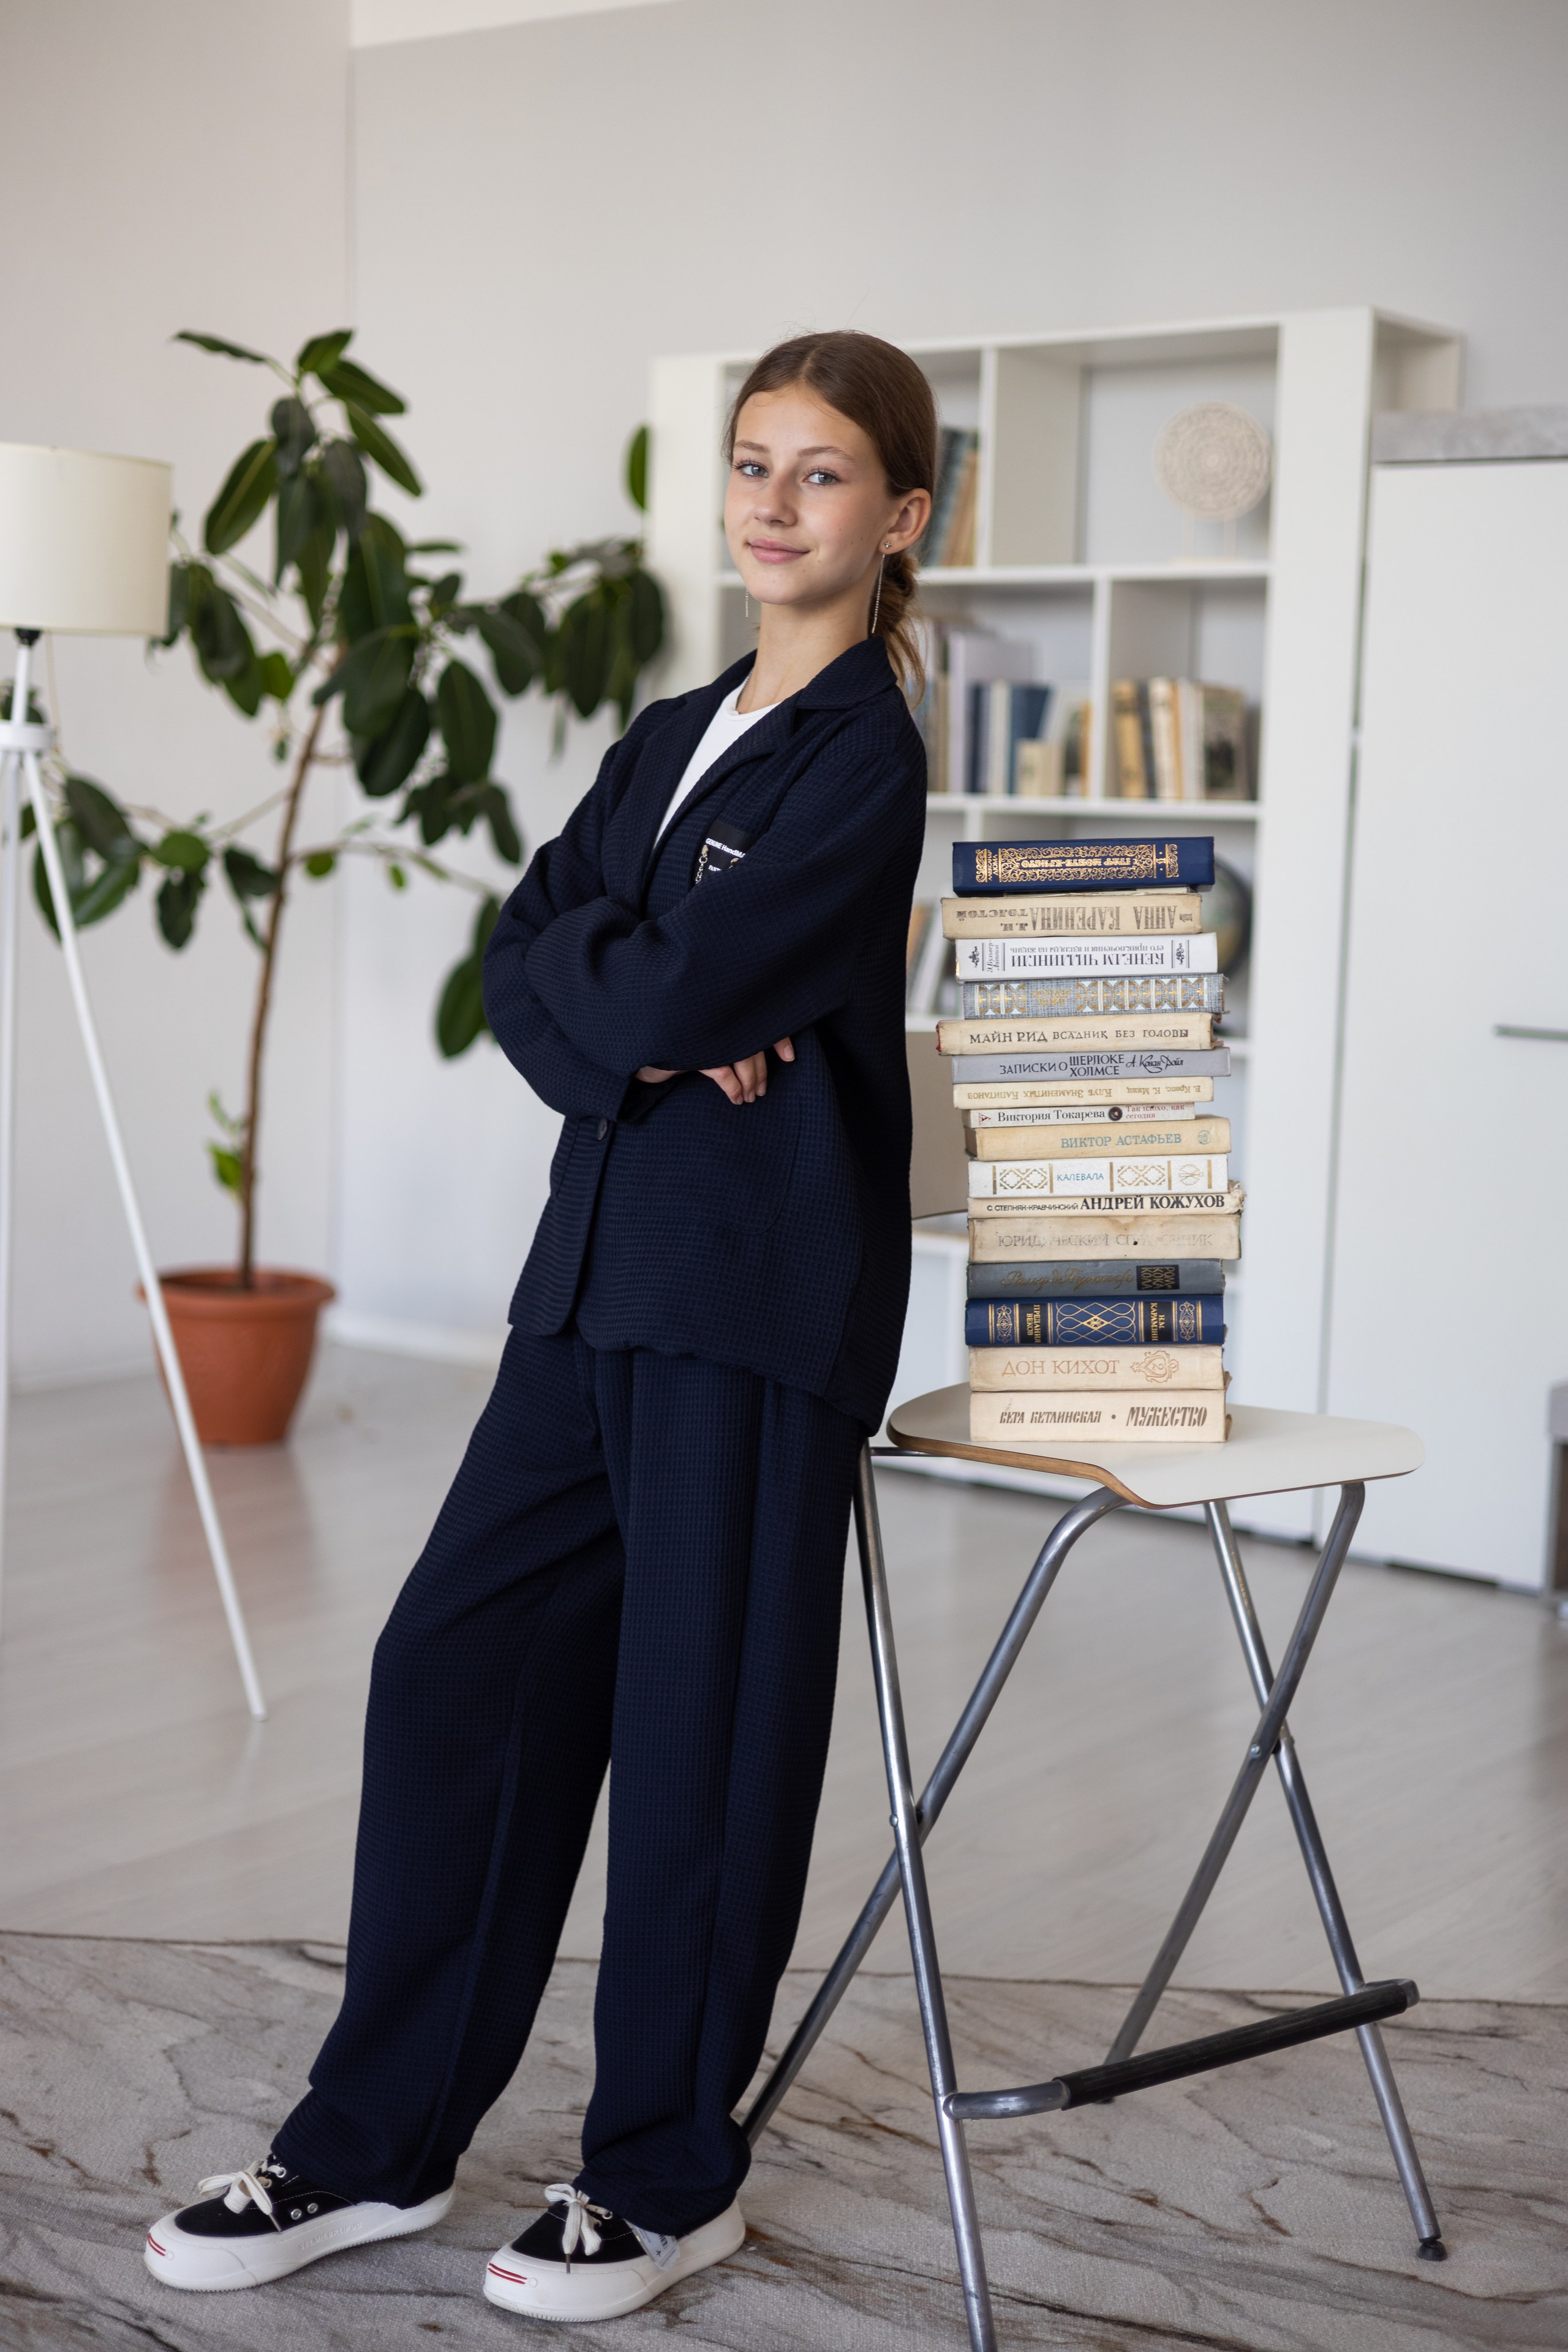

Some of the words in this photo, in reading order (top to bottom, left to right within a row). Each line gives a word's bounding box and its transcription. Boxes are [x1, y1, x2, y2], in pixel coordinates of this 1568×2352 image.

[956, 909, 1028, 921] ТОЛСТОЙ
[1028, 906, 1121, 930] КАРЕНИНА
[1133, 906, 1178, 930] АННА
[1091, 943, 1148, 952] приключения
[1011, 953, 1099, 967] ЧИЛЛИНГЛИ
[1101, 952, 1164, 967] КЕНЕЛМ
[970, 1031, 1012, 1044] МАЙН
[1017, 1031, 1047, 1043] РИД
[1052, 1030, 1109, 1041] ВСАДНИК
[1115, 1030, 1136, 1038] БЕЗ
[1143, 1029, 1189, 1038] ГОЛОВЫ
[1000, 1063, 1057, 1075] ЗАПИСКИ
[1058, 1062, 1068, 1072] О
[1069, 1054, 1125, 1066] ШЕРЛОКЕ
[1069, 1065, 1120, 1077] ХОЛМСЕ
[1139, 1055, 1163, 1073] Конан
[1161, 1055, 1183, 1070] Дойл
[1126, 1087, 1150, 1095] Минц
[998, 1111, 1051, 1122] Виктория
[1054, 1109, 1105, 1120] Токарева
[1060, 1137, 1112, 1148] ВИКТОР
[1115, 1134, 1182, 1145] АСТАФЬЕВ
[1057, 1172, 1104, 1182] КАЛЕВАЛА
[995, 1202, 1078, 1212] СТЕПНЯК-КРАВЧИНСКИЙ
[1080, 1196, 1144, 1210] АНДРЕЙ
[1150, 1195, 1225, 1209] КОЖУХОВ
[998, 1233, 1109, 1248] ЮРИДЧЕСКИЙ
[1141, 1267, 1152, 1289] КОЛА
[1152, 1267, 1164, 1289] КОКА
[1164, 1267, 1175, 1285] РОМ
[1002, 1360, 1045, 1377] ДОН
[1051, 1359, 1120, 1374] КИХОТ
[1000, 1411, 1025, 1424] ВЕРА
[1030, 1411, 1102, 1424] КЕТЛИНСКАЯ
[1126, 1406, 1208, 1427] МУЖЕСТВО
